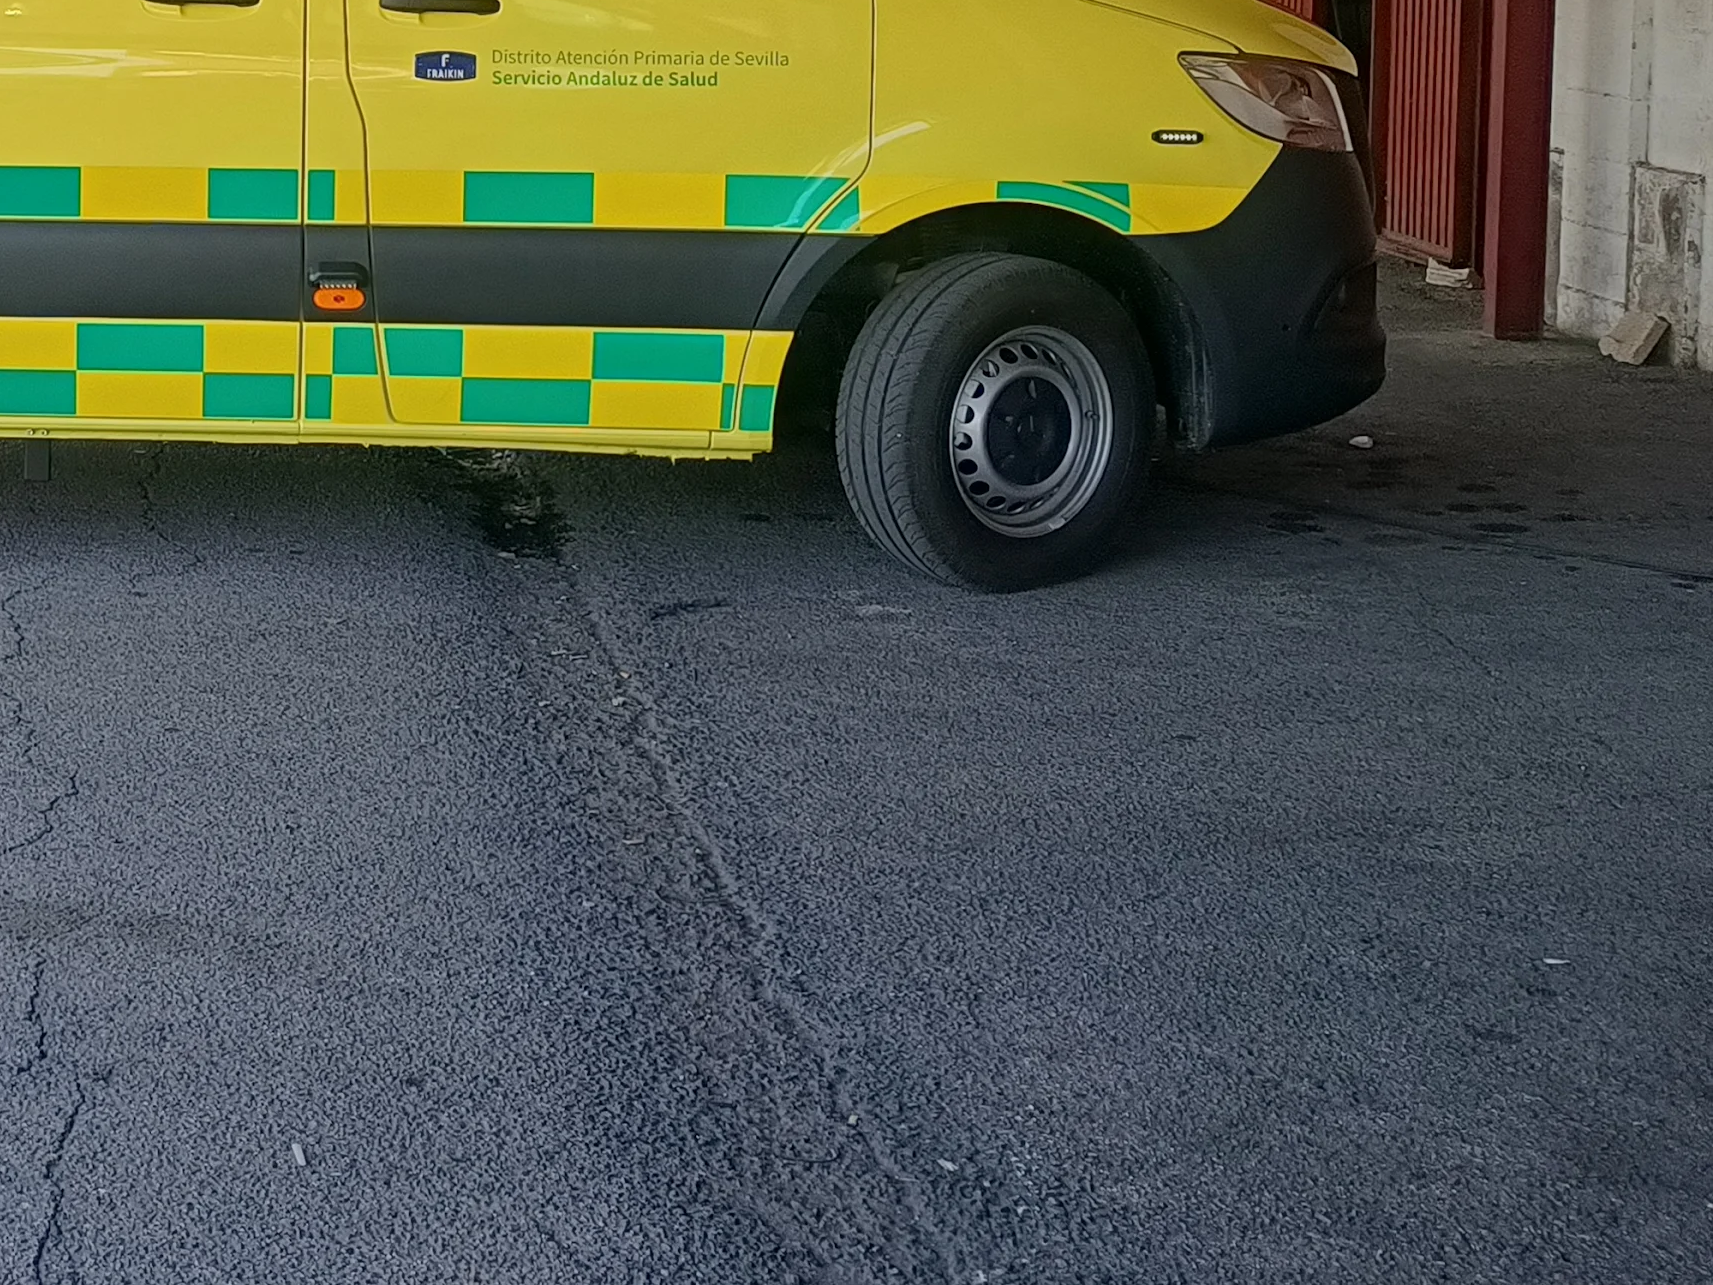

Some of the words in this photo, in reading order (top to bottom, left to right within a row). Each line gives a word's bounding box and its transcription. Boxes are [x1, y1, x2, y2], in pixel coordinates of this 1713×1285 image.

[492, 49, 551, 65] Distrito
[556, 49, 628, 65] Atención
[634, 50, 704, 65] Primaria
[709, 50, 730, 65] de
[734, 50, 789, 66] Sevilla
[427, 68, 464, 79] FRAIKIN
[492, 70, 562, 86] Servicio
[566, 71, 638, 86] Andaluz
[642, 71, 663, 86] de
[668, 71, 718, 87] Salud
